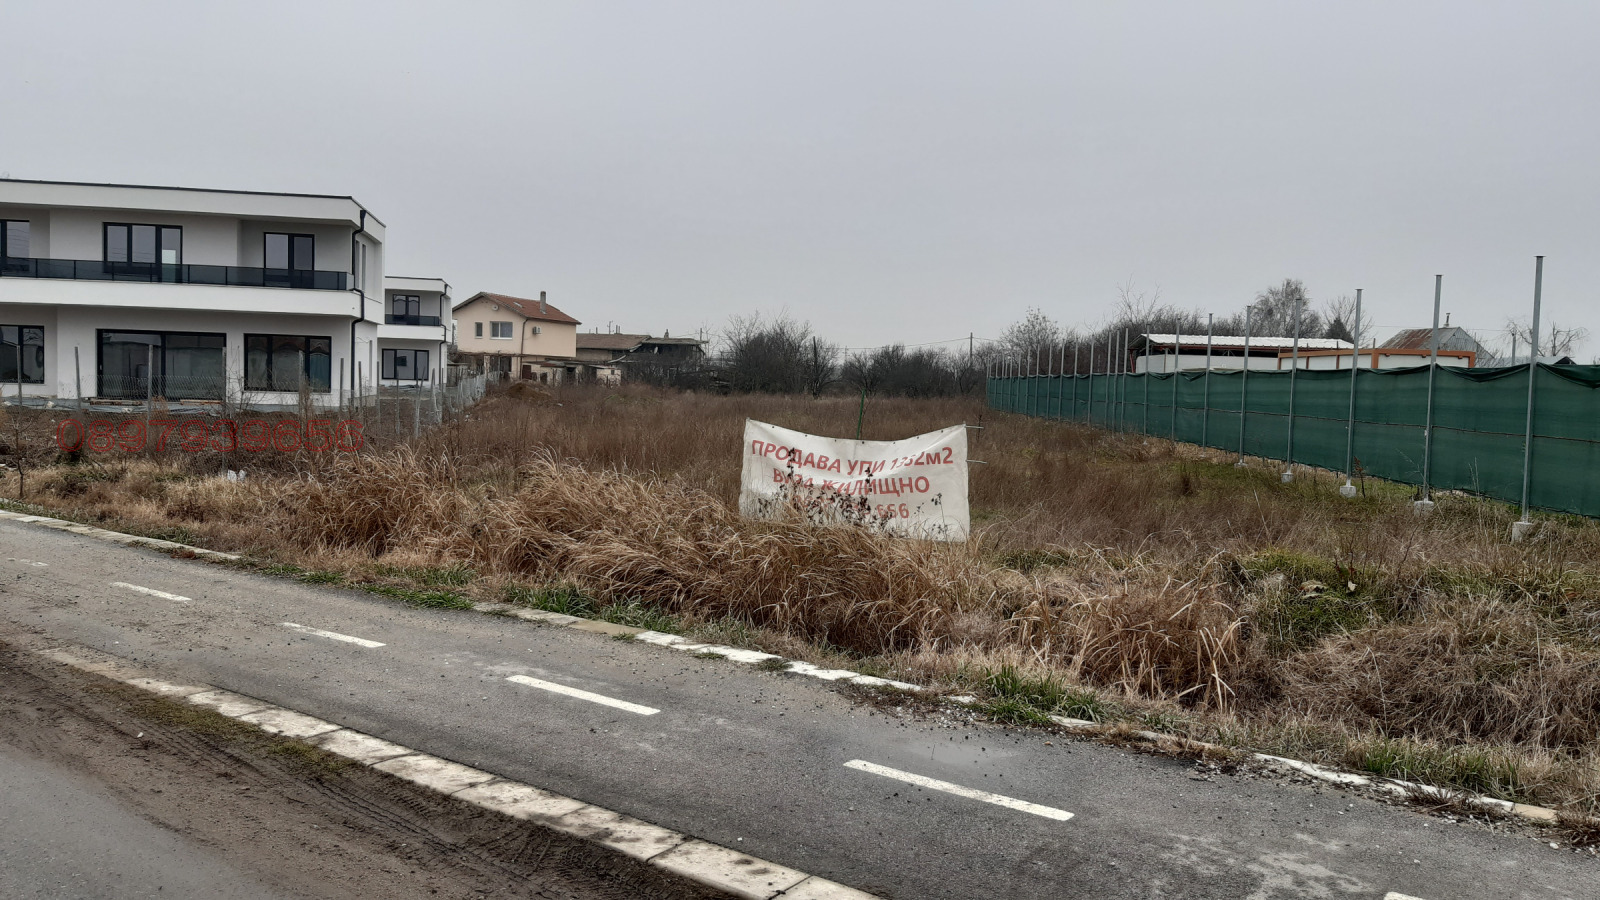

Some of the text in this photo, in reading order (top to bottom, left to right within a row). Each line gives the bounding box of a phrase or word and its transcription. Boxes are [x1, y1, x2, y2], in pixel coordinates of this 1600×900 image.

[752, 440, 841, 473] ПРОДАВА
[847, 460, 886, 475] УПИ
[822, 476, 930, 497] ЖИЛИЩНО
